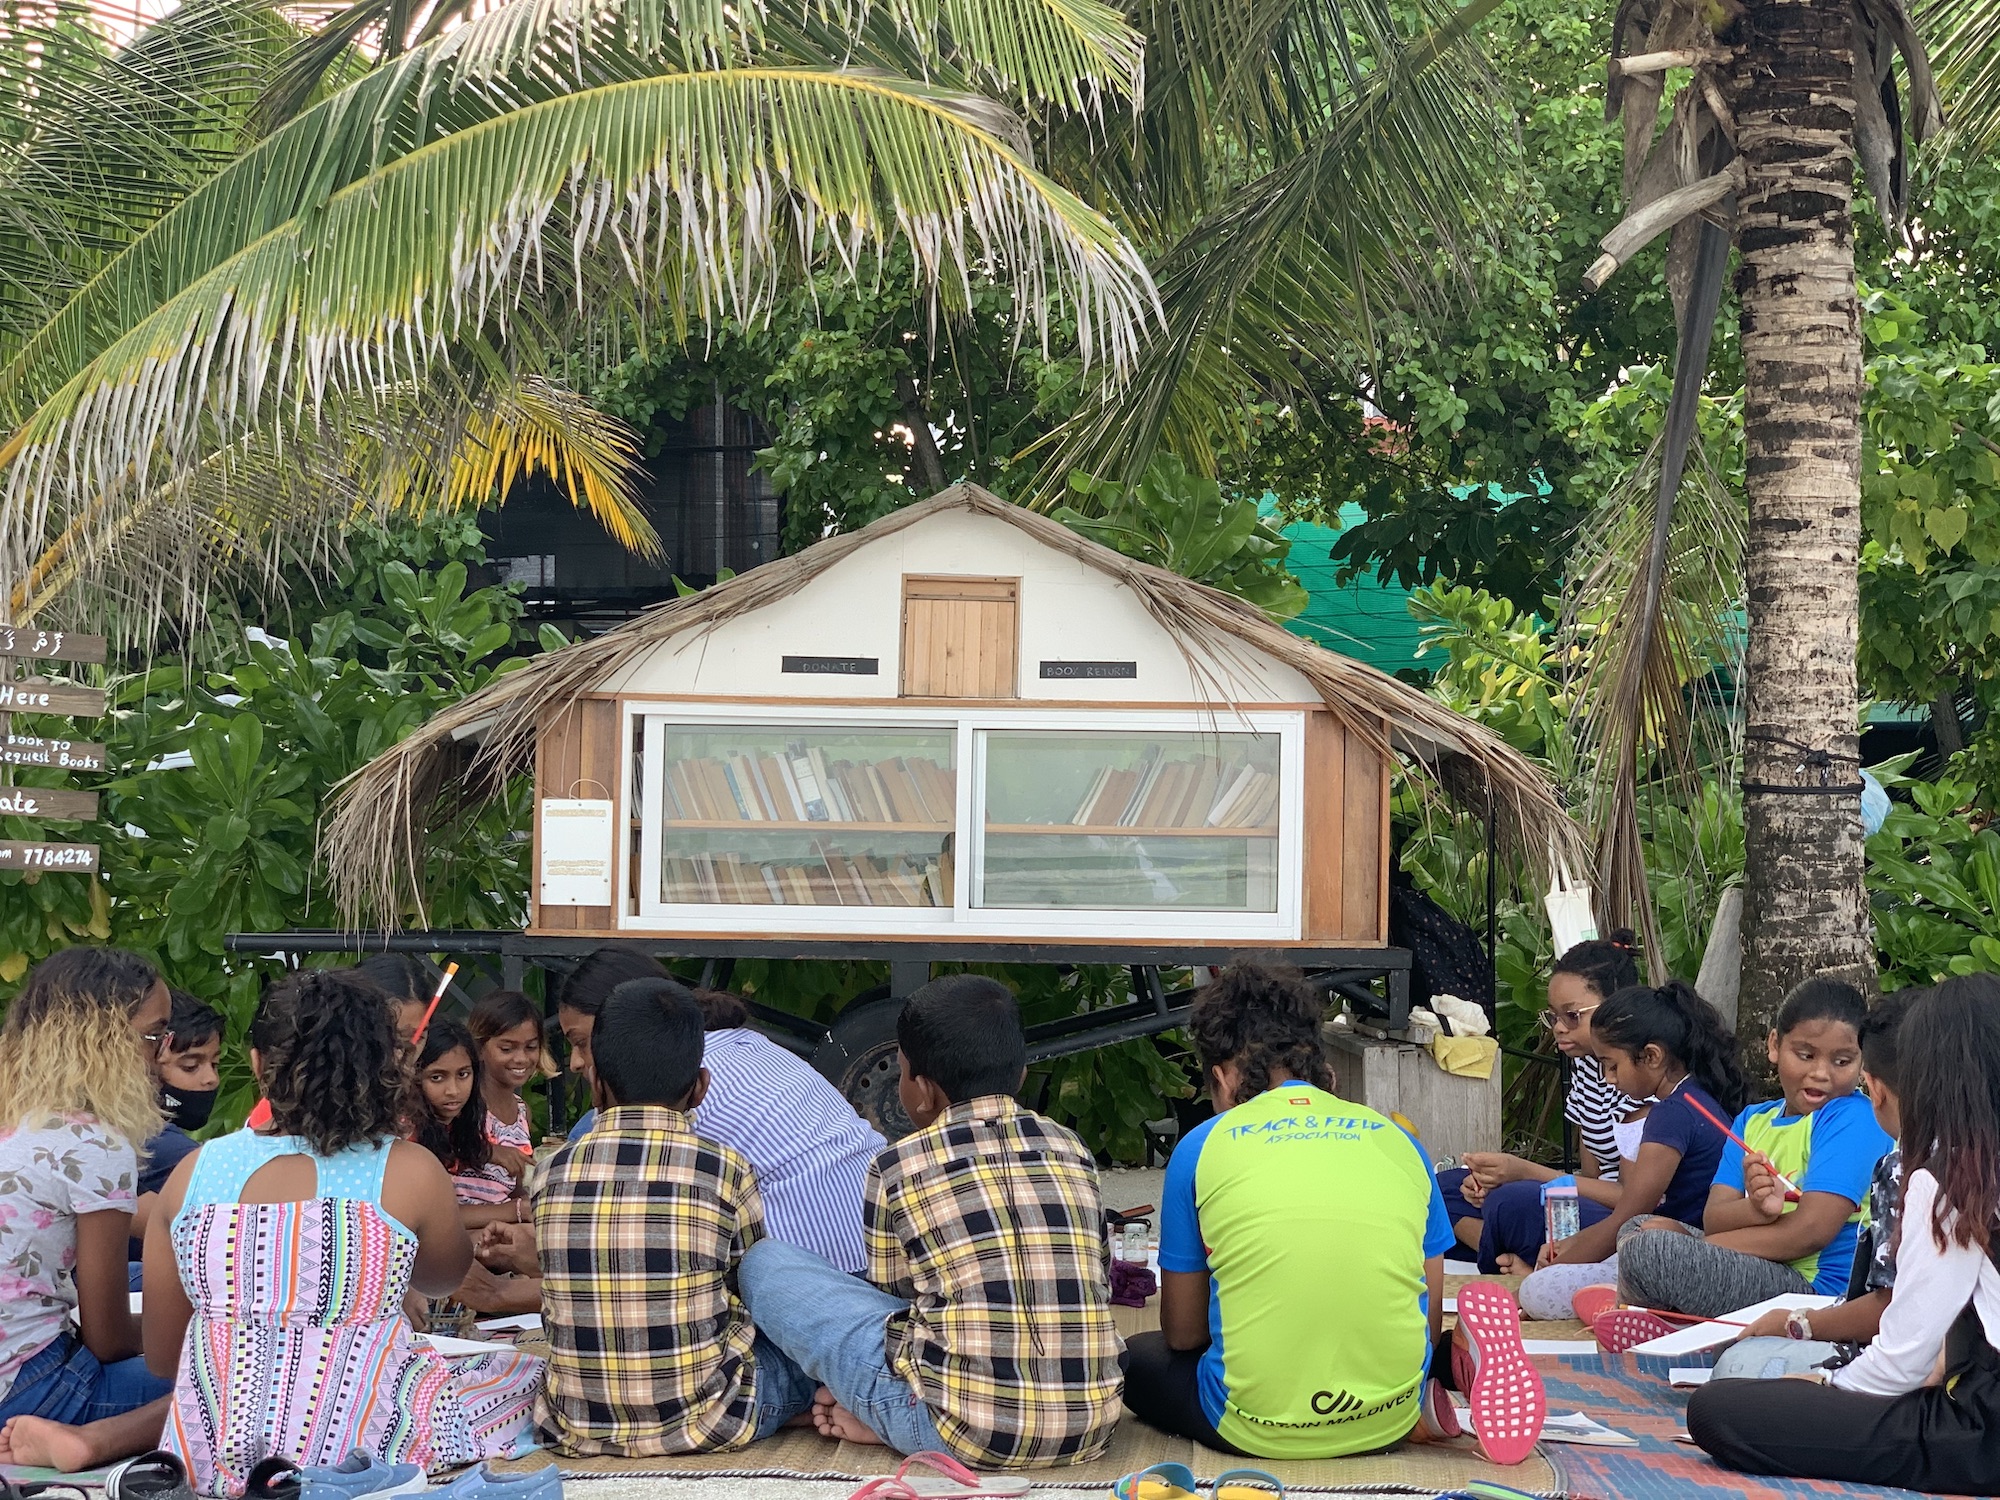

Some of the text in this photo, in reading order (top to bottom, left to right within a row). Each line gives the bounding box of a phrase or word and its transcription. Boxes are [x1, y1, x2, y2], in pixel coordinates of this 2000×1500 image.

[802, 662, 857, 673] DONATE
[0, 685, 50, 707] Here
[59, 752, 100, 769] Books
[24, 848, 93, 866] 7784274
[1223, 1115, 1386, 1141] TRACK & FIELD
[1264, 1131, 1361, 1144] ASSOCIATION
[1326, 1386, 1415, 1426] MALDIVES
